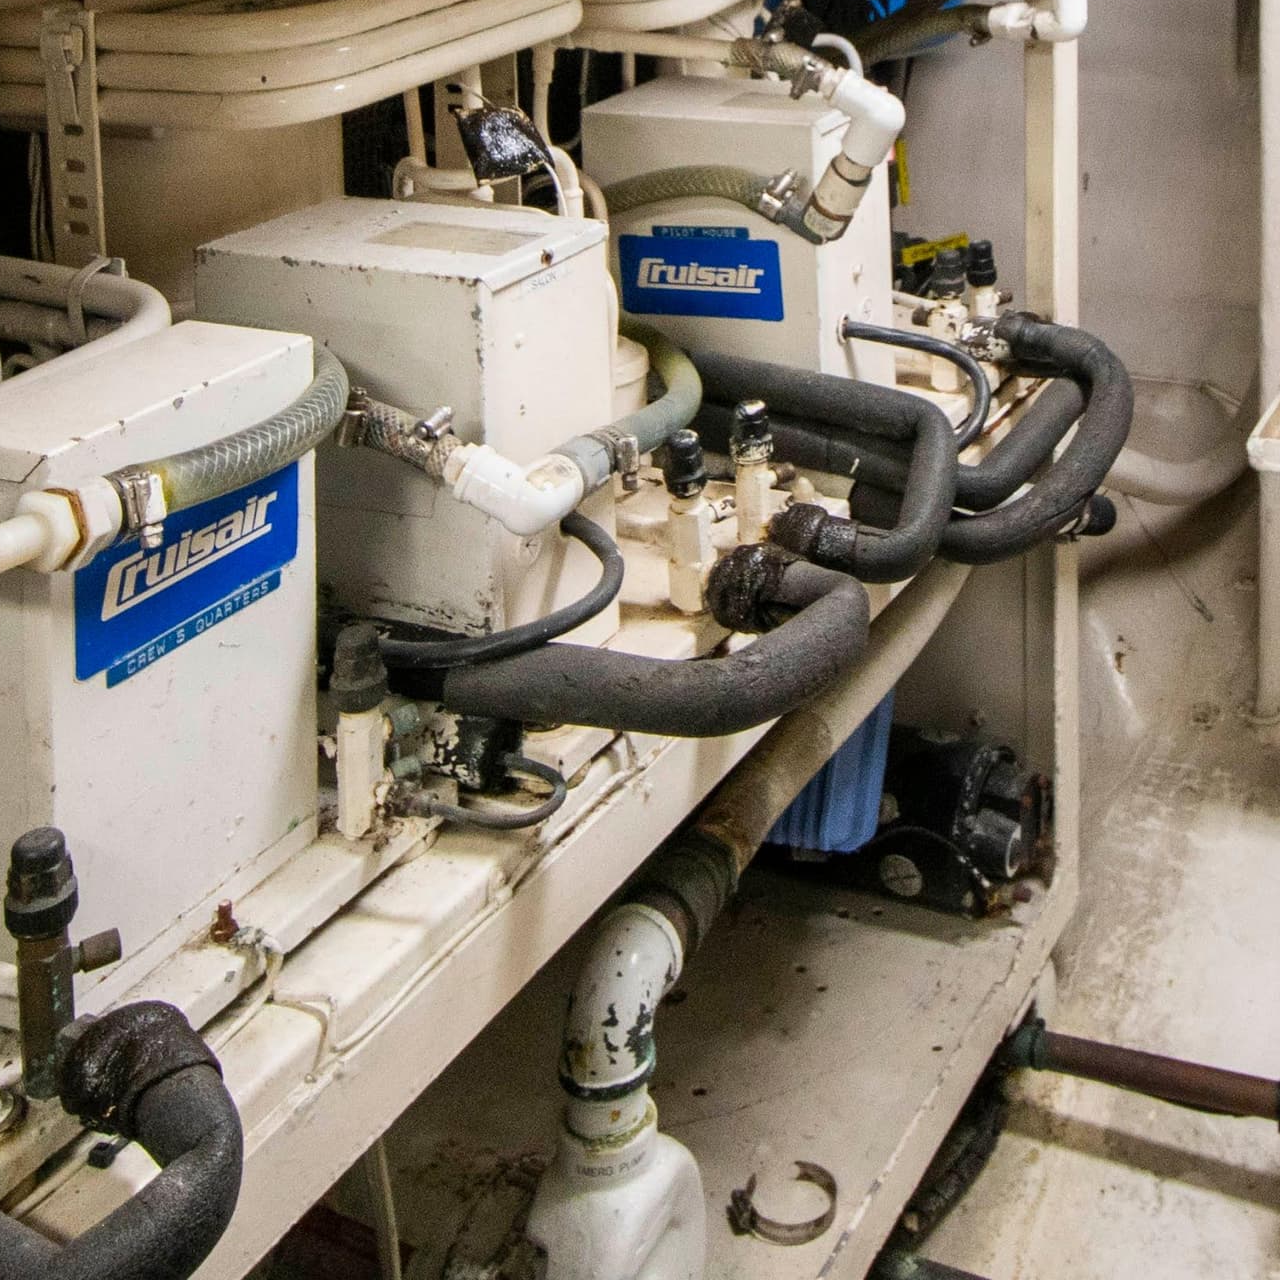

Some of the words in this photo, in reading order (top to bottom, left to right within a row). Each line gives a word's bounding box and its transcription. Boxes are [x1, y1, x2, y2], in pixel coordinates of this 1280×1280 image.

[637, 257, 765, 295] Cruisair
[101, 491, 278, 622] Cruisair
[196, 581, 270, 632] QUARTERS
